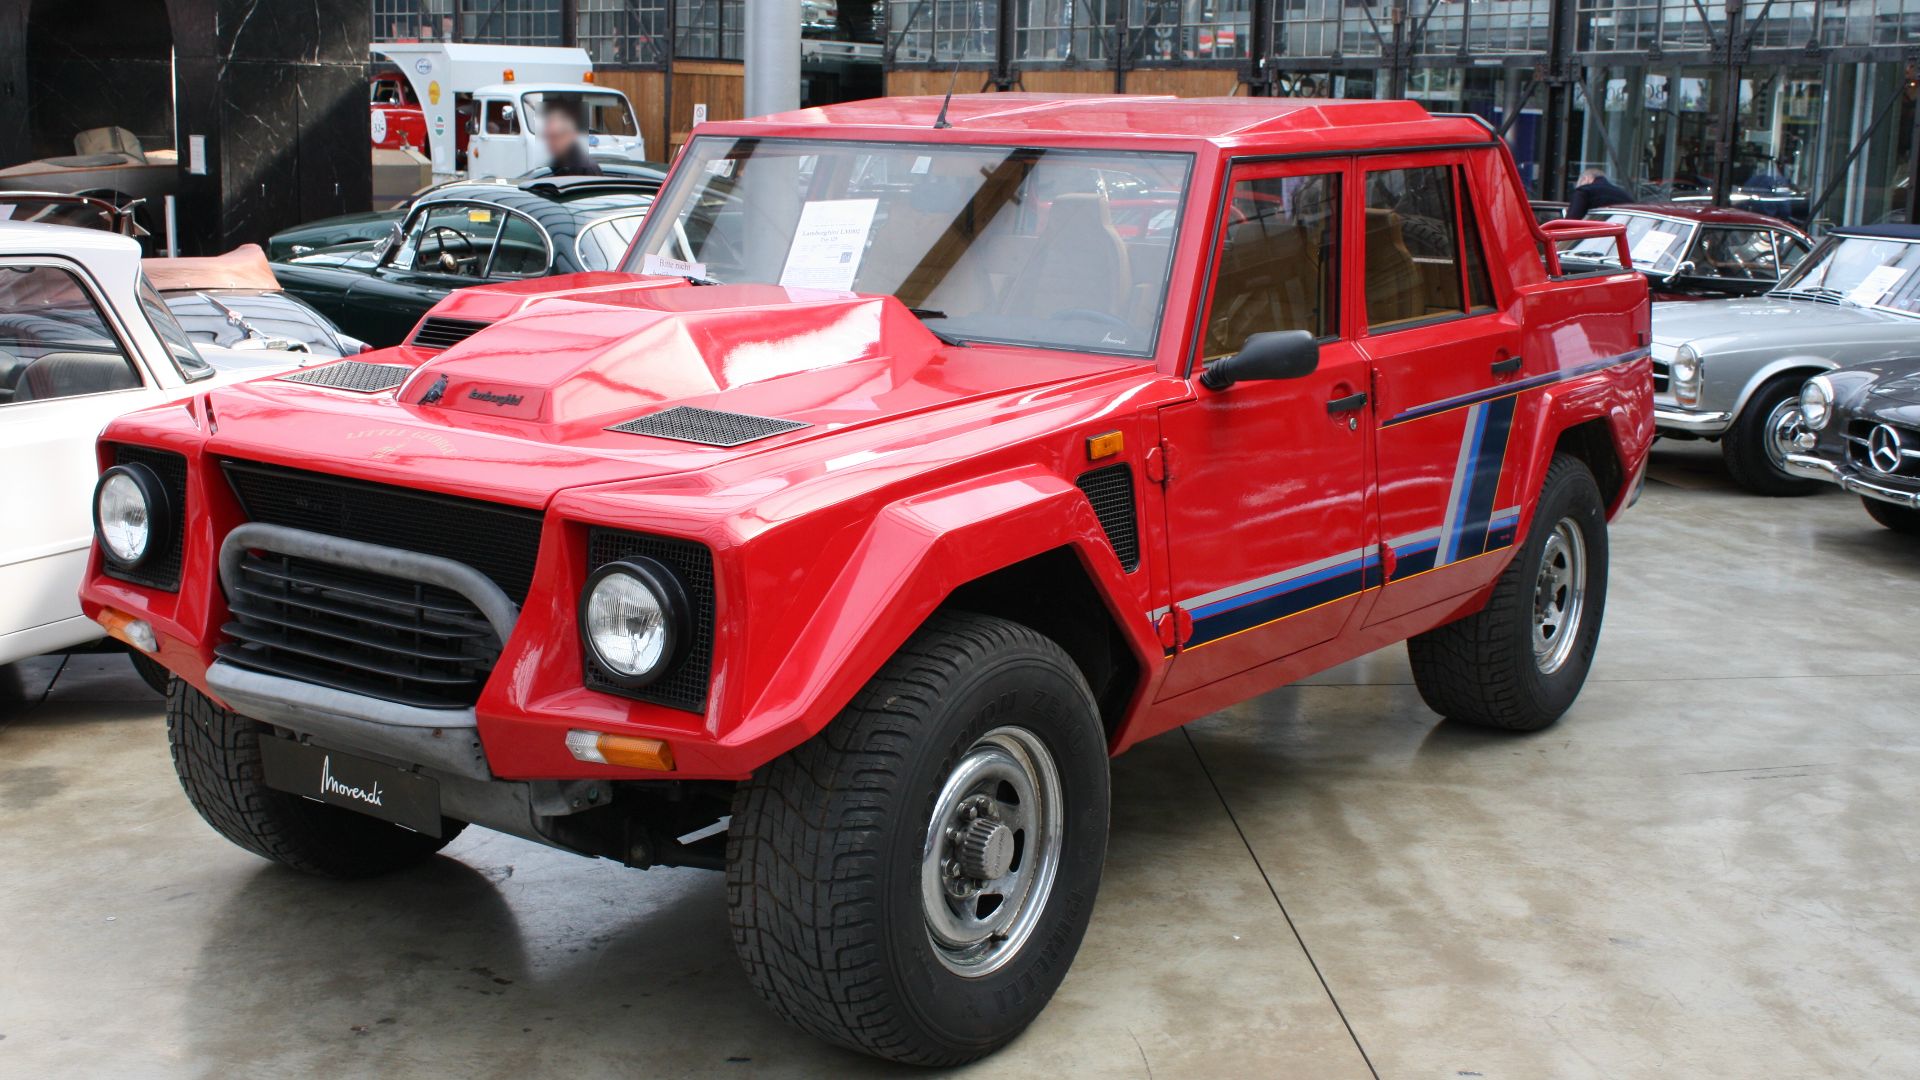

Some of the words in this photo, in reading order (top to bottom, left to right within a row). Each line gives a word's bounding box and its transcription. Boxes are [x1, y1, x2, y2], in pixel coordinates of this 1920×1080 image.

[346, 428, 407, 440] LITTLE
[411, 430, 463, 456] GEORGE
[321, 755, 383, 806] Movendi
[992, 887, 1085, 1015] PIRELLI
